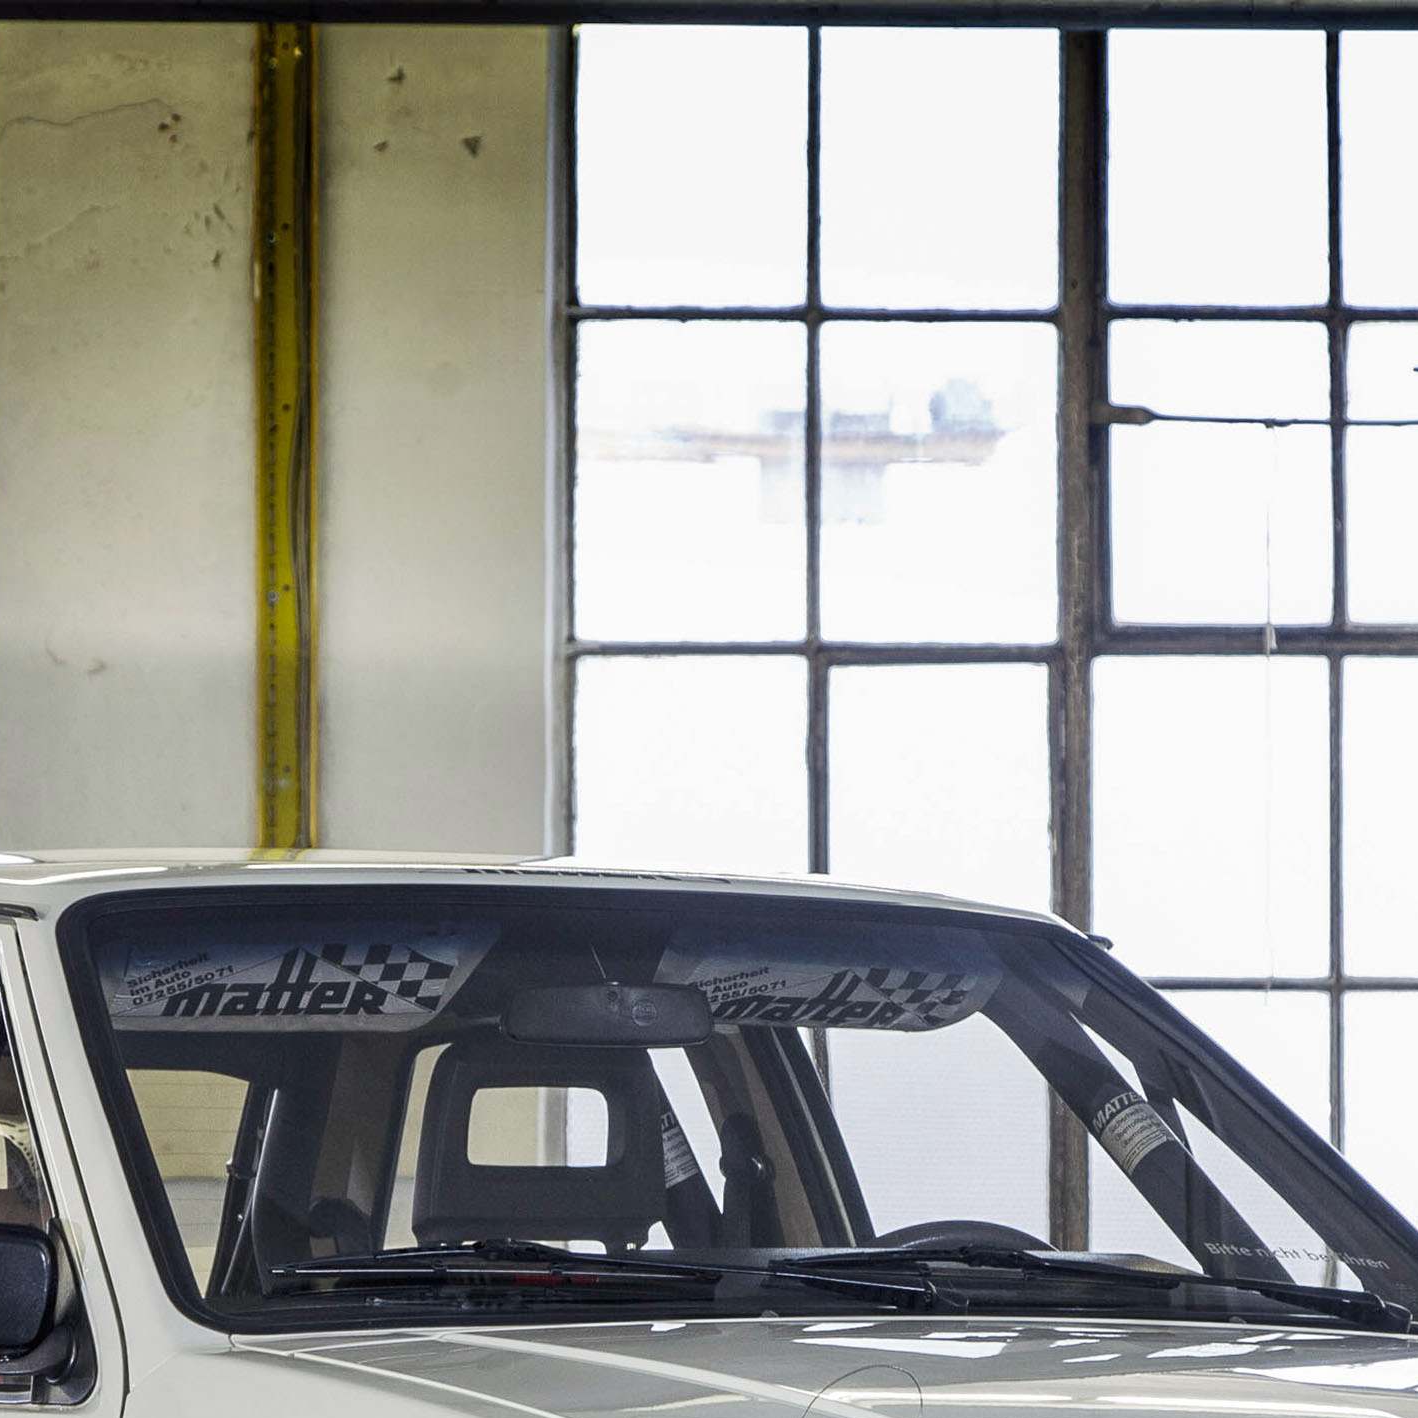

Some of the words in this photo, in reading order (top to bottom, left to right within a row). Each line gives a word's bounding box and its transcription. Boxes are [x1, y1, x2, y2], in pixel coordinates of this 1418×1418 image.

[127, 952, 208, 989] Sicherheit
[154, 970, 191, 989] Auto
[709, 980, 787, 1003] 255/5071
[1092, 1090, 1142, 1134] MATTE
[1203, 1241, 1255, 1257] Bitte
